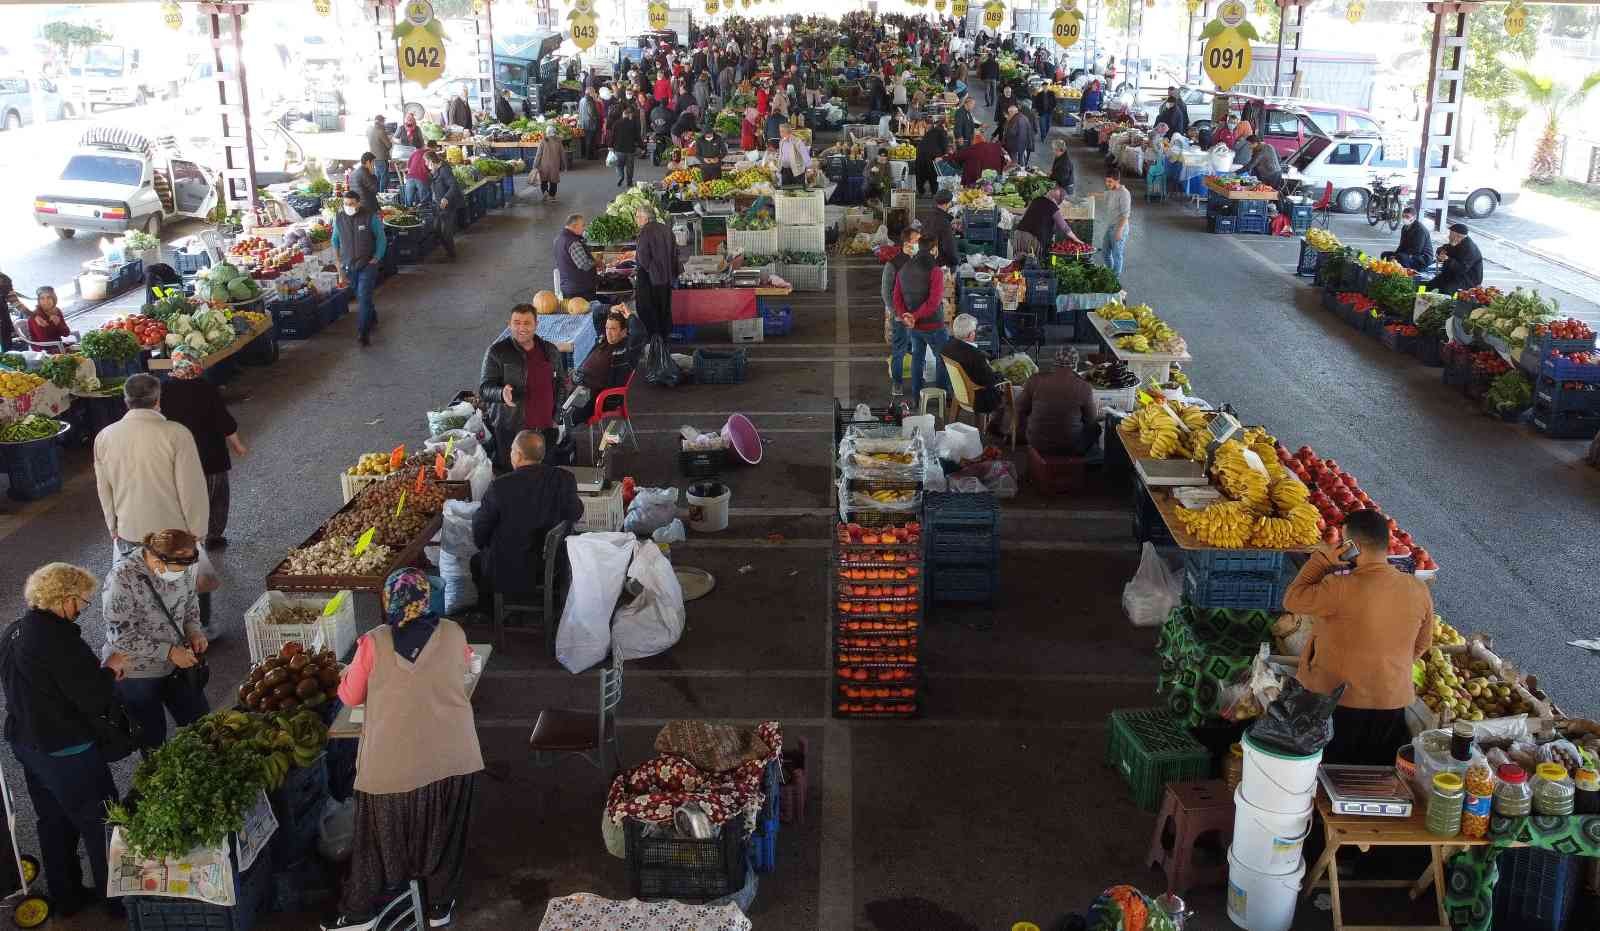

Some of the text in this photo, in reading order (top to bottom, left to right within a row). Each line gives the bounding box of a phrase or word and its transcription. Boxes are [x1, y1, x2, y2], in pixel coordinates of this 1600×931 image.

[650, 13, 666, 23] 044
[986, 12, 1002, 22] 089
[573, 25, 595, 38] 043
[1056, 24, 1077, 37] 090
[404, 46, 440, 67] 042
[1209, 48, 1244, 69] 091
